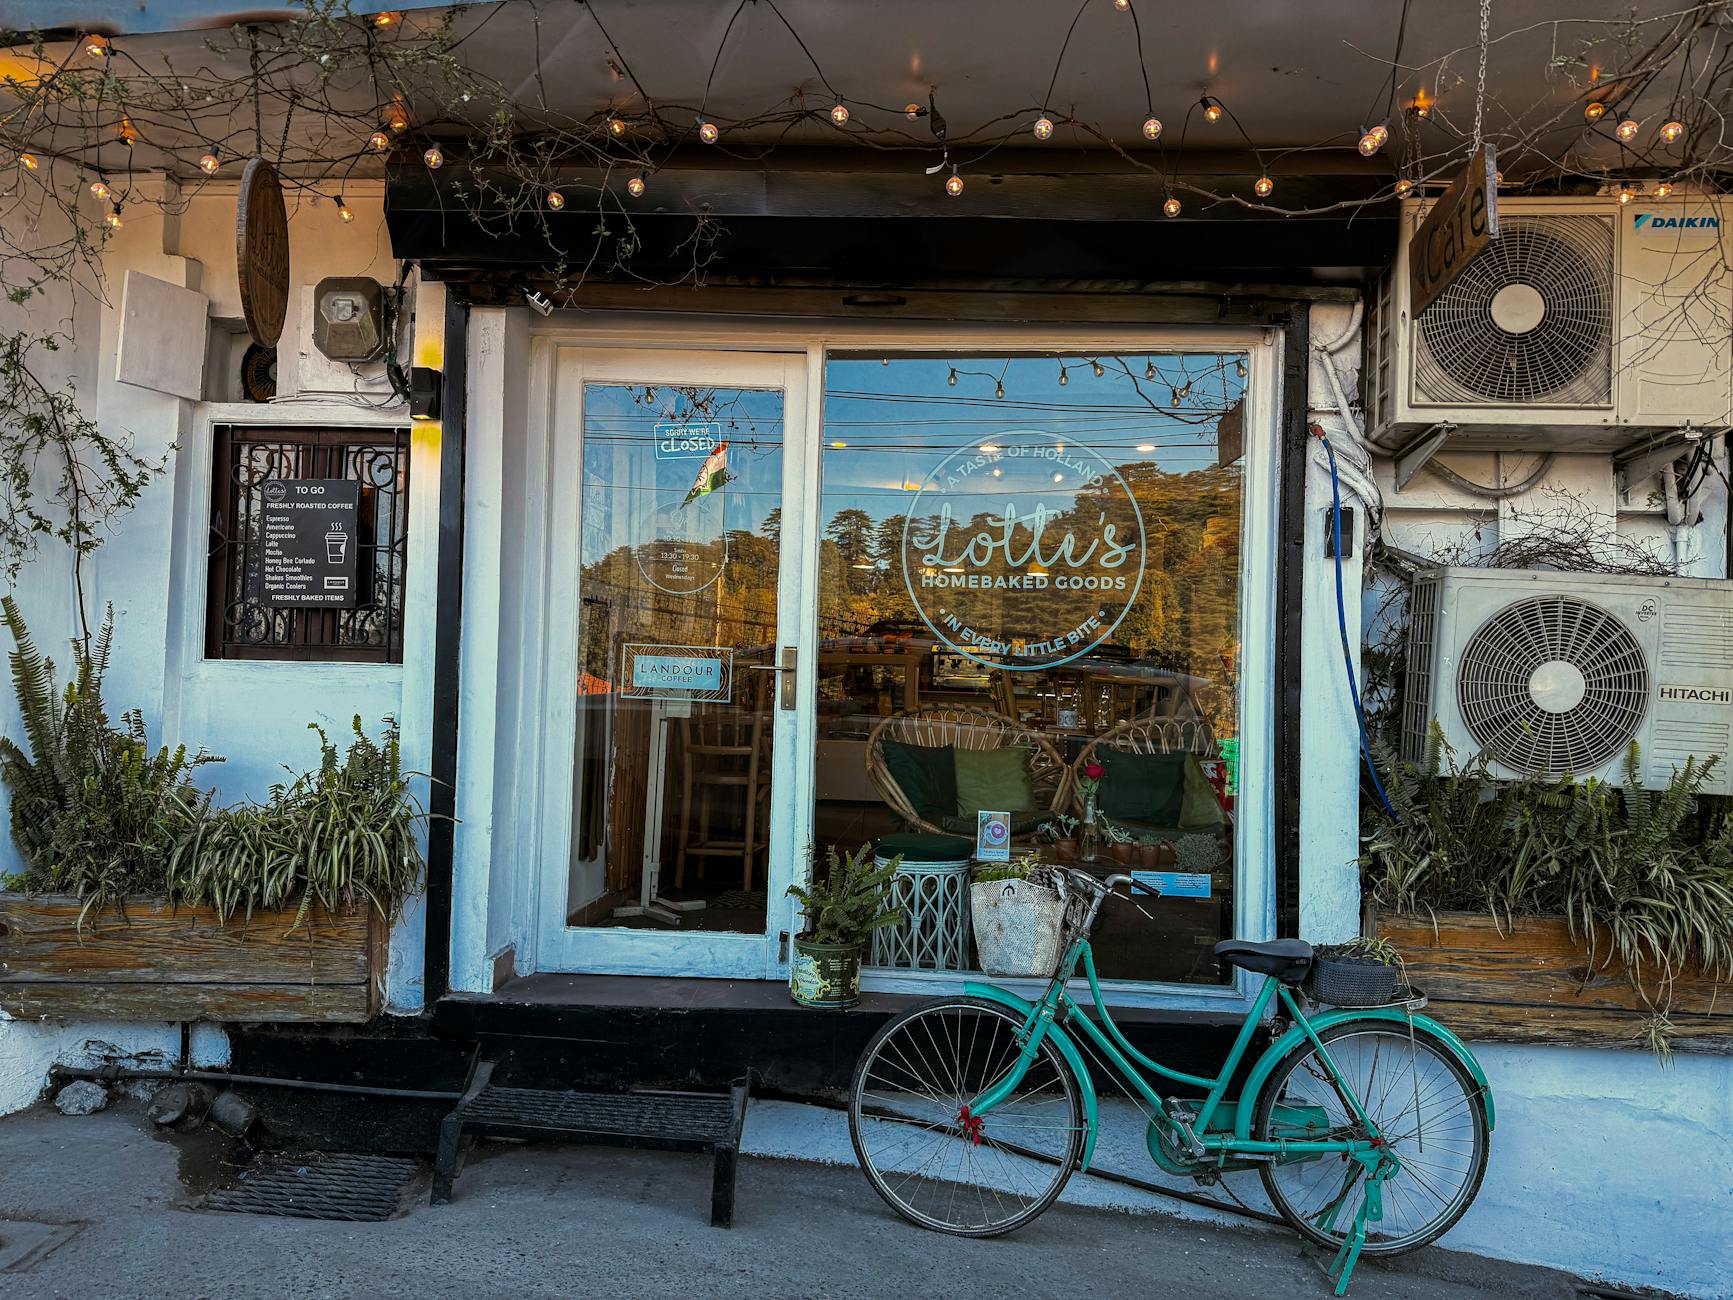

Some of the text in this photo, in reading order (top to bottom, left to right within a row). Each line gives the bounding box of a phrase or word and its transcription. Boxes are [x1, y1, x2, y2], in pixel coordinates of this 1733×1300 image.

[1651, 217, 1720, 228] DAIKIN
[665, 428, 688, 436] SORRY
[661, 436, 715, 453] CLOSED
[948, 446, 1105, 489] A TASTE OF HOLLAND
[296, 486, 325, 494] TO GO
[266, 532, 296, 540] Cappuccino
[912, 502, 1136, 568] Lotte's
[921, 575, 1127, 590] HOMEBAKED GOODS
[944, 613, 1101, 657] IN EVERY LITTLE BITE
[641, 663, 713, 676] LANDOUR
[661, 675, 692, 683] COFFEE
[1660, 688, 1729, 702] HITACHI
